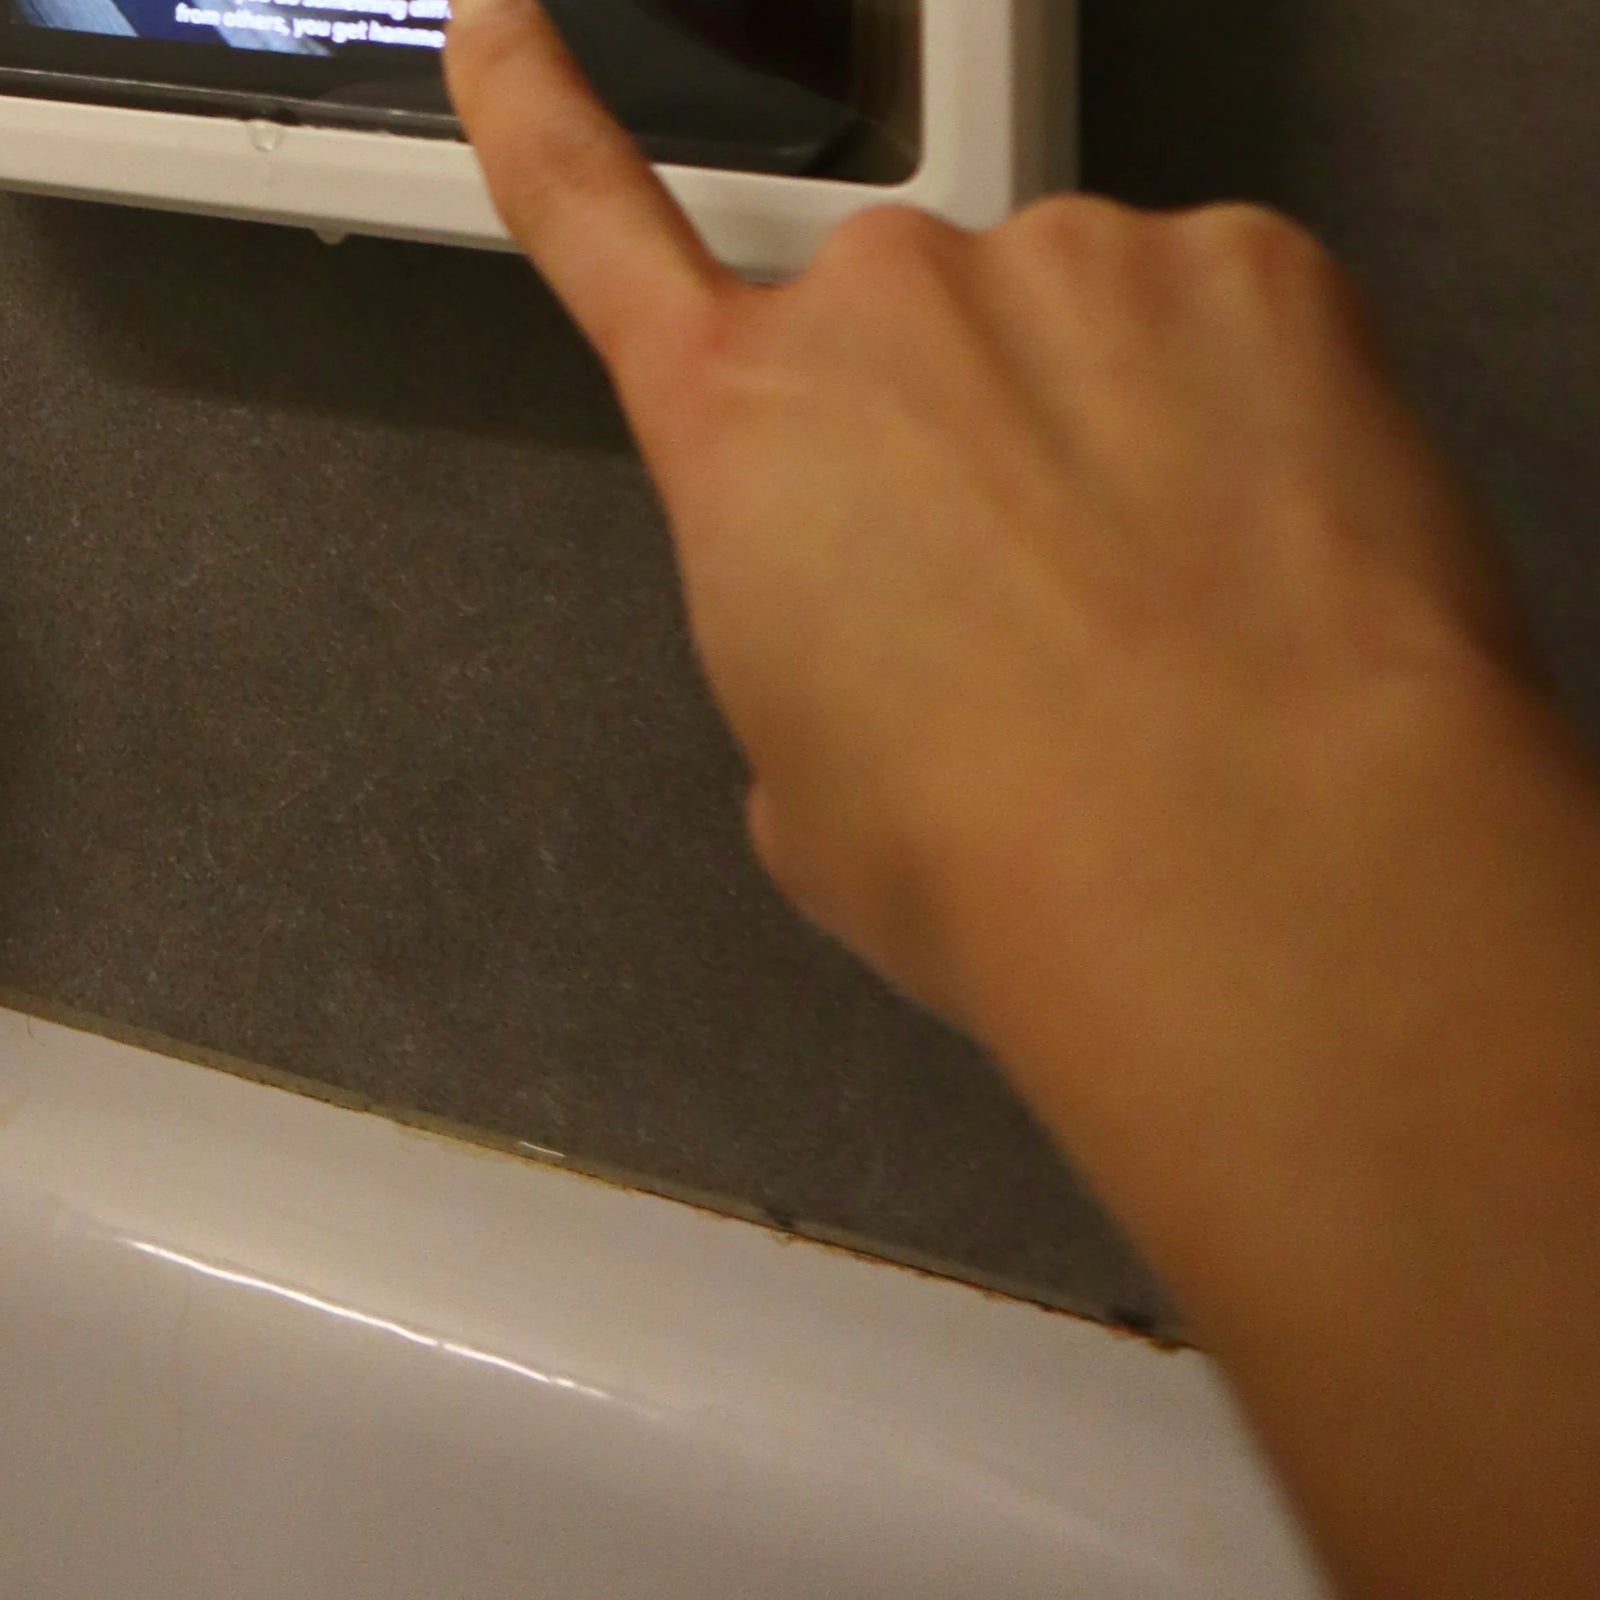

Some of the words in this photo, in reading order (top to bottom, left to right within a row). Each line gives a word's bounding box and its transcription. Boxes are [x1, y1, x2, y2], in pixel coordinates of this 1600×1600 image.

[175, 2, 220, 25] from
[223, 9, 290, 36] others,
[293, 17, 331, 38] you
[333, 20, 368, 44] get
[369, 19, 446, 48] hamme
